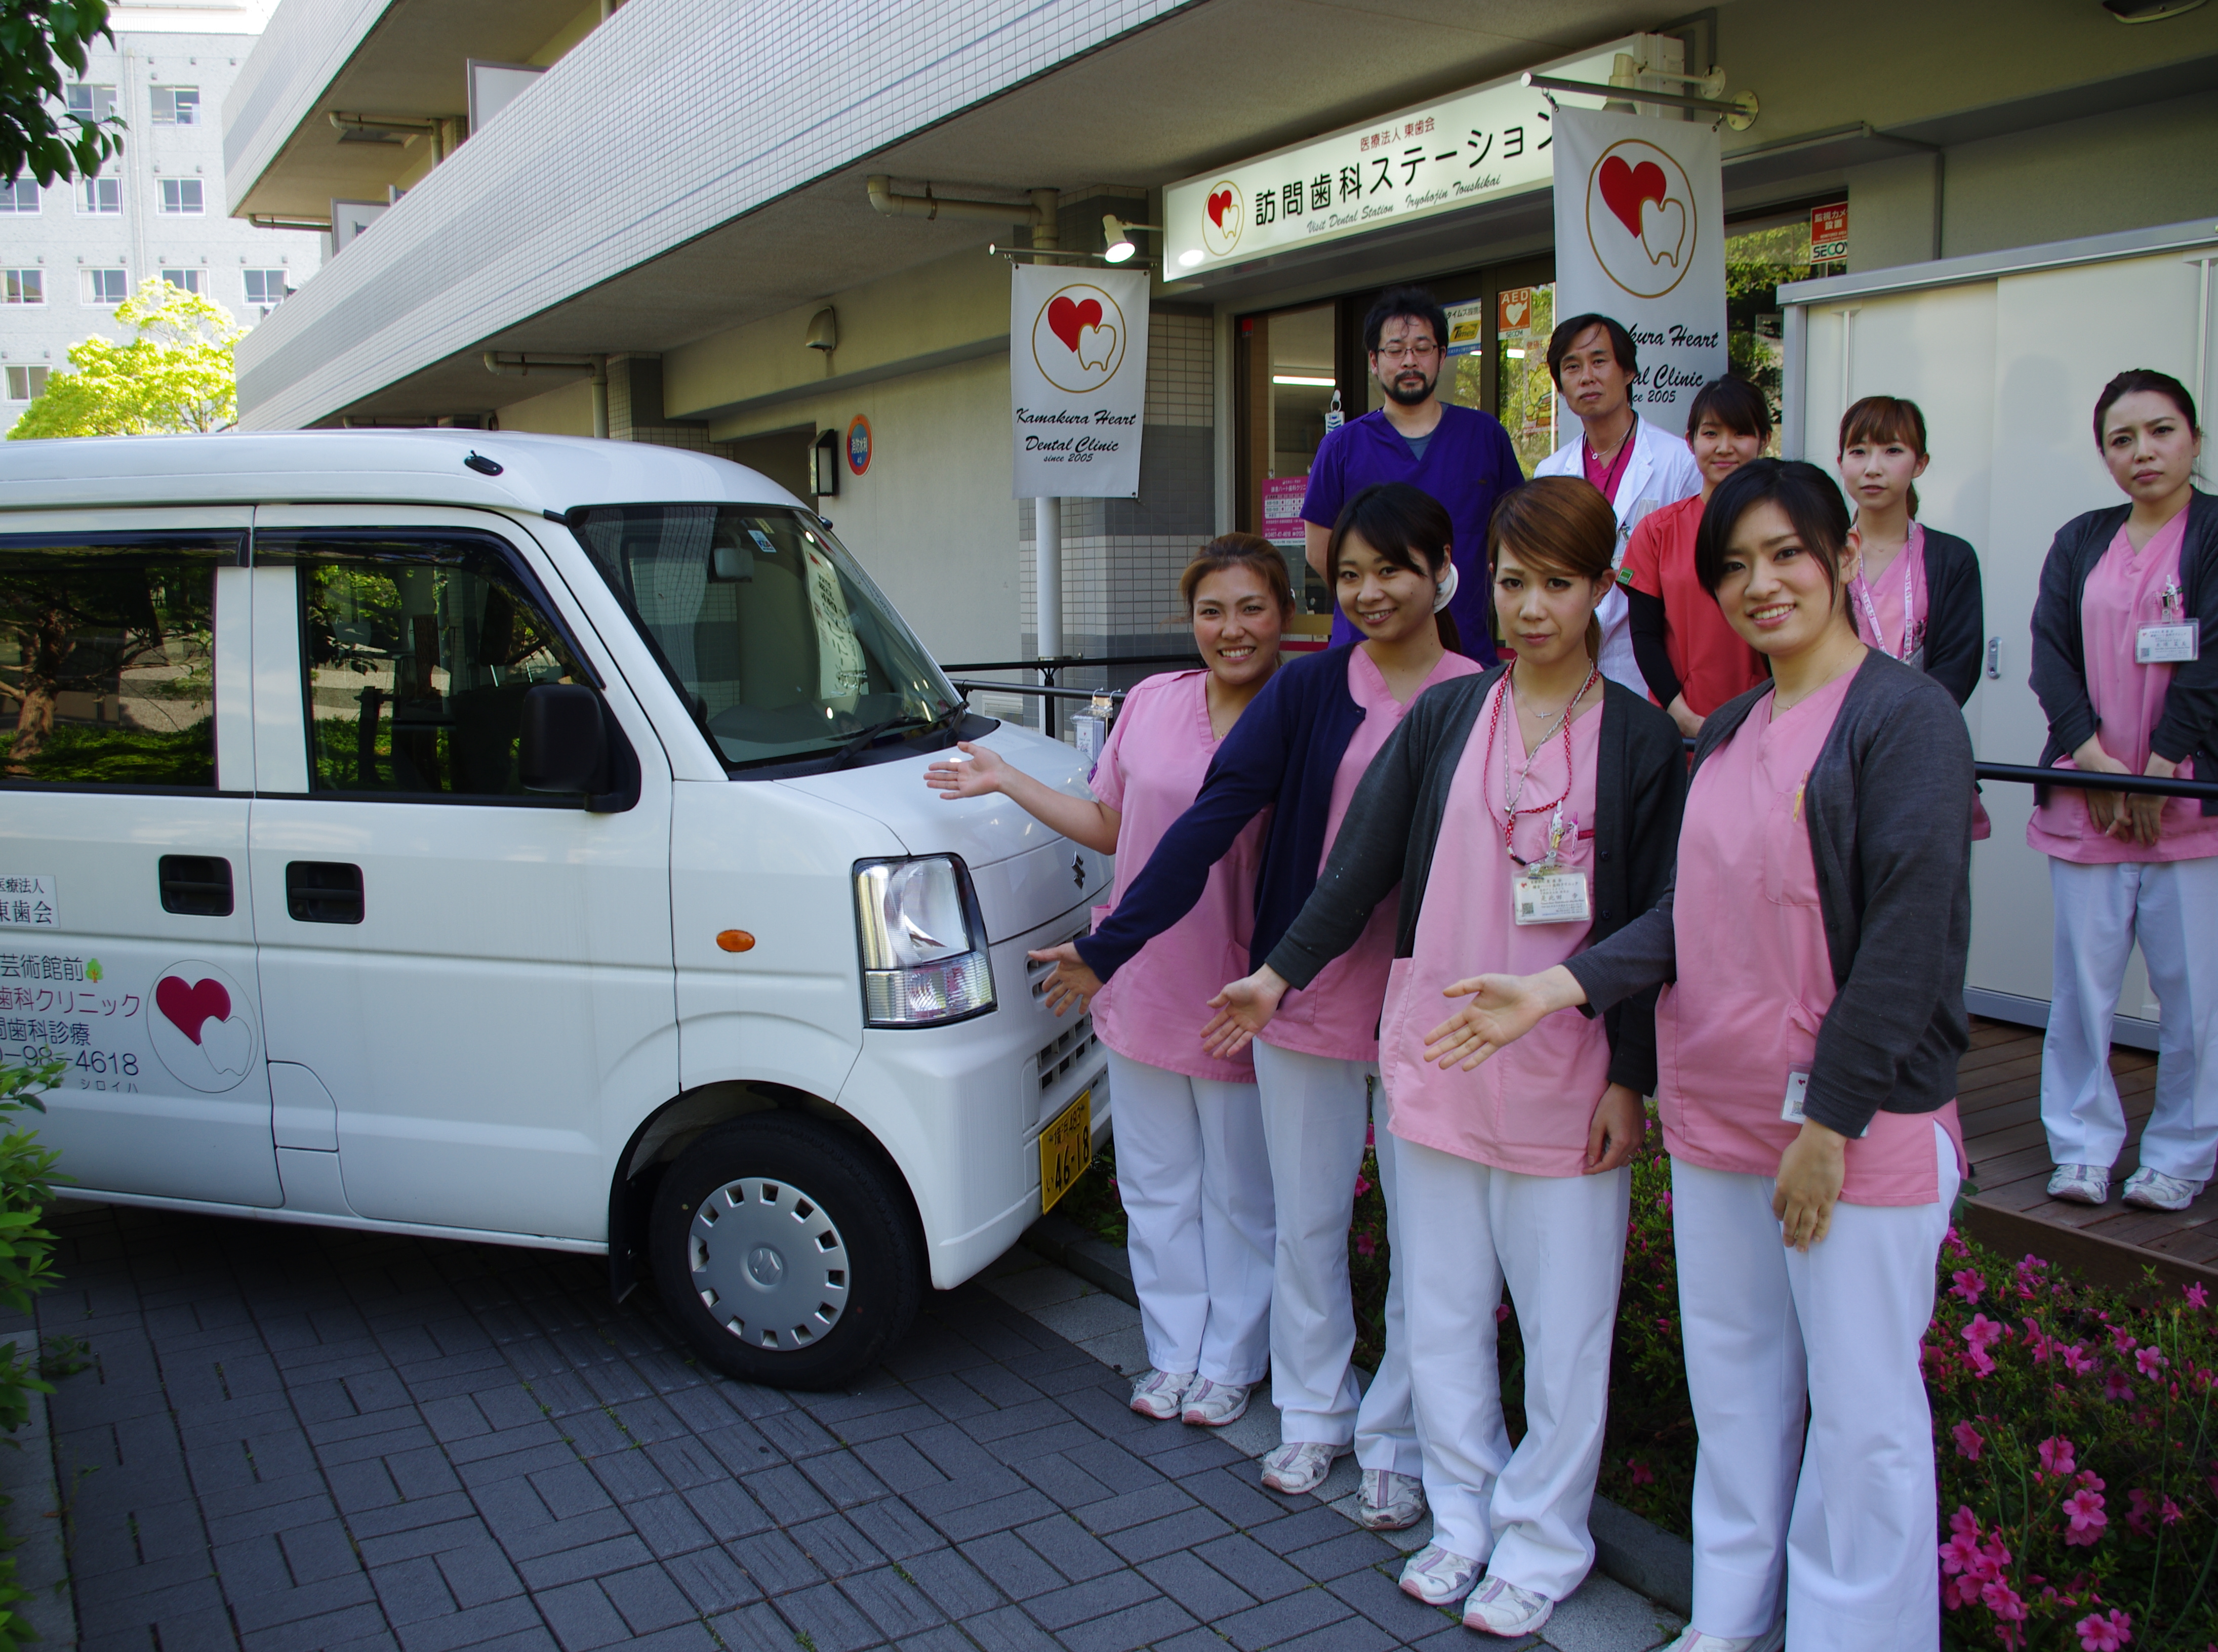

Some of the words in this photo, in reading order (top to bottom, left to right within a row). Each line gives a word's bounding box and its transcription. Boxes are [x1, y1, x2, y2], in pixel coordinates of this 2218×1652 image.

[1360, 127, 1401, 152] 医療法人
[1404, 116, 1435, 137] 東歯会
[1256, 111, 1553, 226] 訪問歯科ステーション
[1307, 220, 1326, 234] Visit
[1329, 210, 1358, 229] Dental
[1361, 203, 1394, 221] Station
[1453, 174, 1501, 196] Toushikai
[1814, 209, 1847, 223] 監視カメ
[1813, 242, 1847, 259] SECO
[1501, 290, 1529, 305] AED
[1454, 323, 1478, 340] Times
[1506, 329, 1523, 339] SECOM
[1627, 323, 1665, 345] kura
[1669, 324, 1719, 348] Heart
[1653, 364, 1704, 389] Clinic
[1647, 390, 1676, 403] 2005
[1016, 408, 1090, 425] Kamakura
[1094, 409, 1137, 426] Heart
[1025, 435, 1073, 451] Dental
[1075, 436, 1119, 453] Clinic
[1043, 453, 1064, 463] since
[1067, 453, 1094, 463] 2005
[0, 953, 84, 981] 芸術館前
[0, 986, 139, 1017] 歯科クリニック
[0, 1045, 139, 1076] -98-4618
